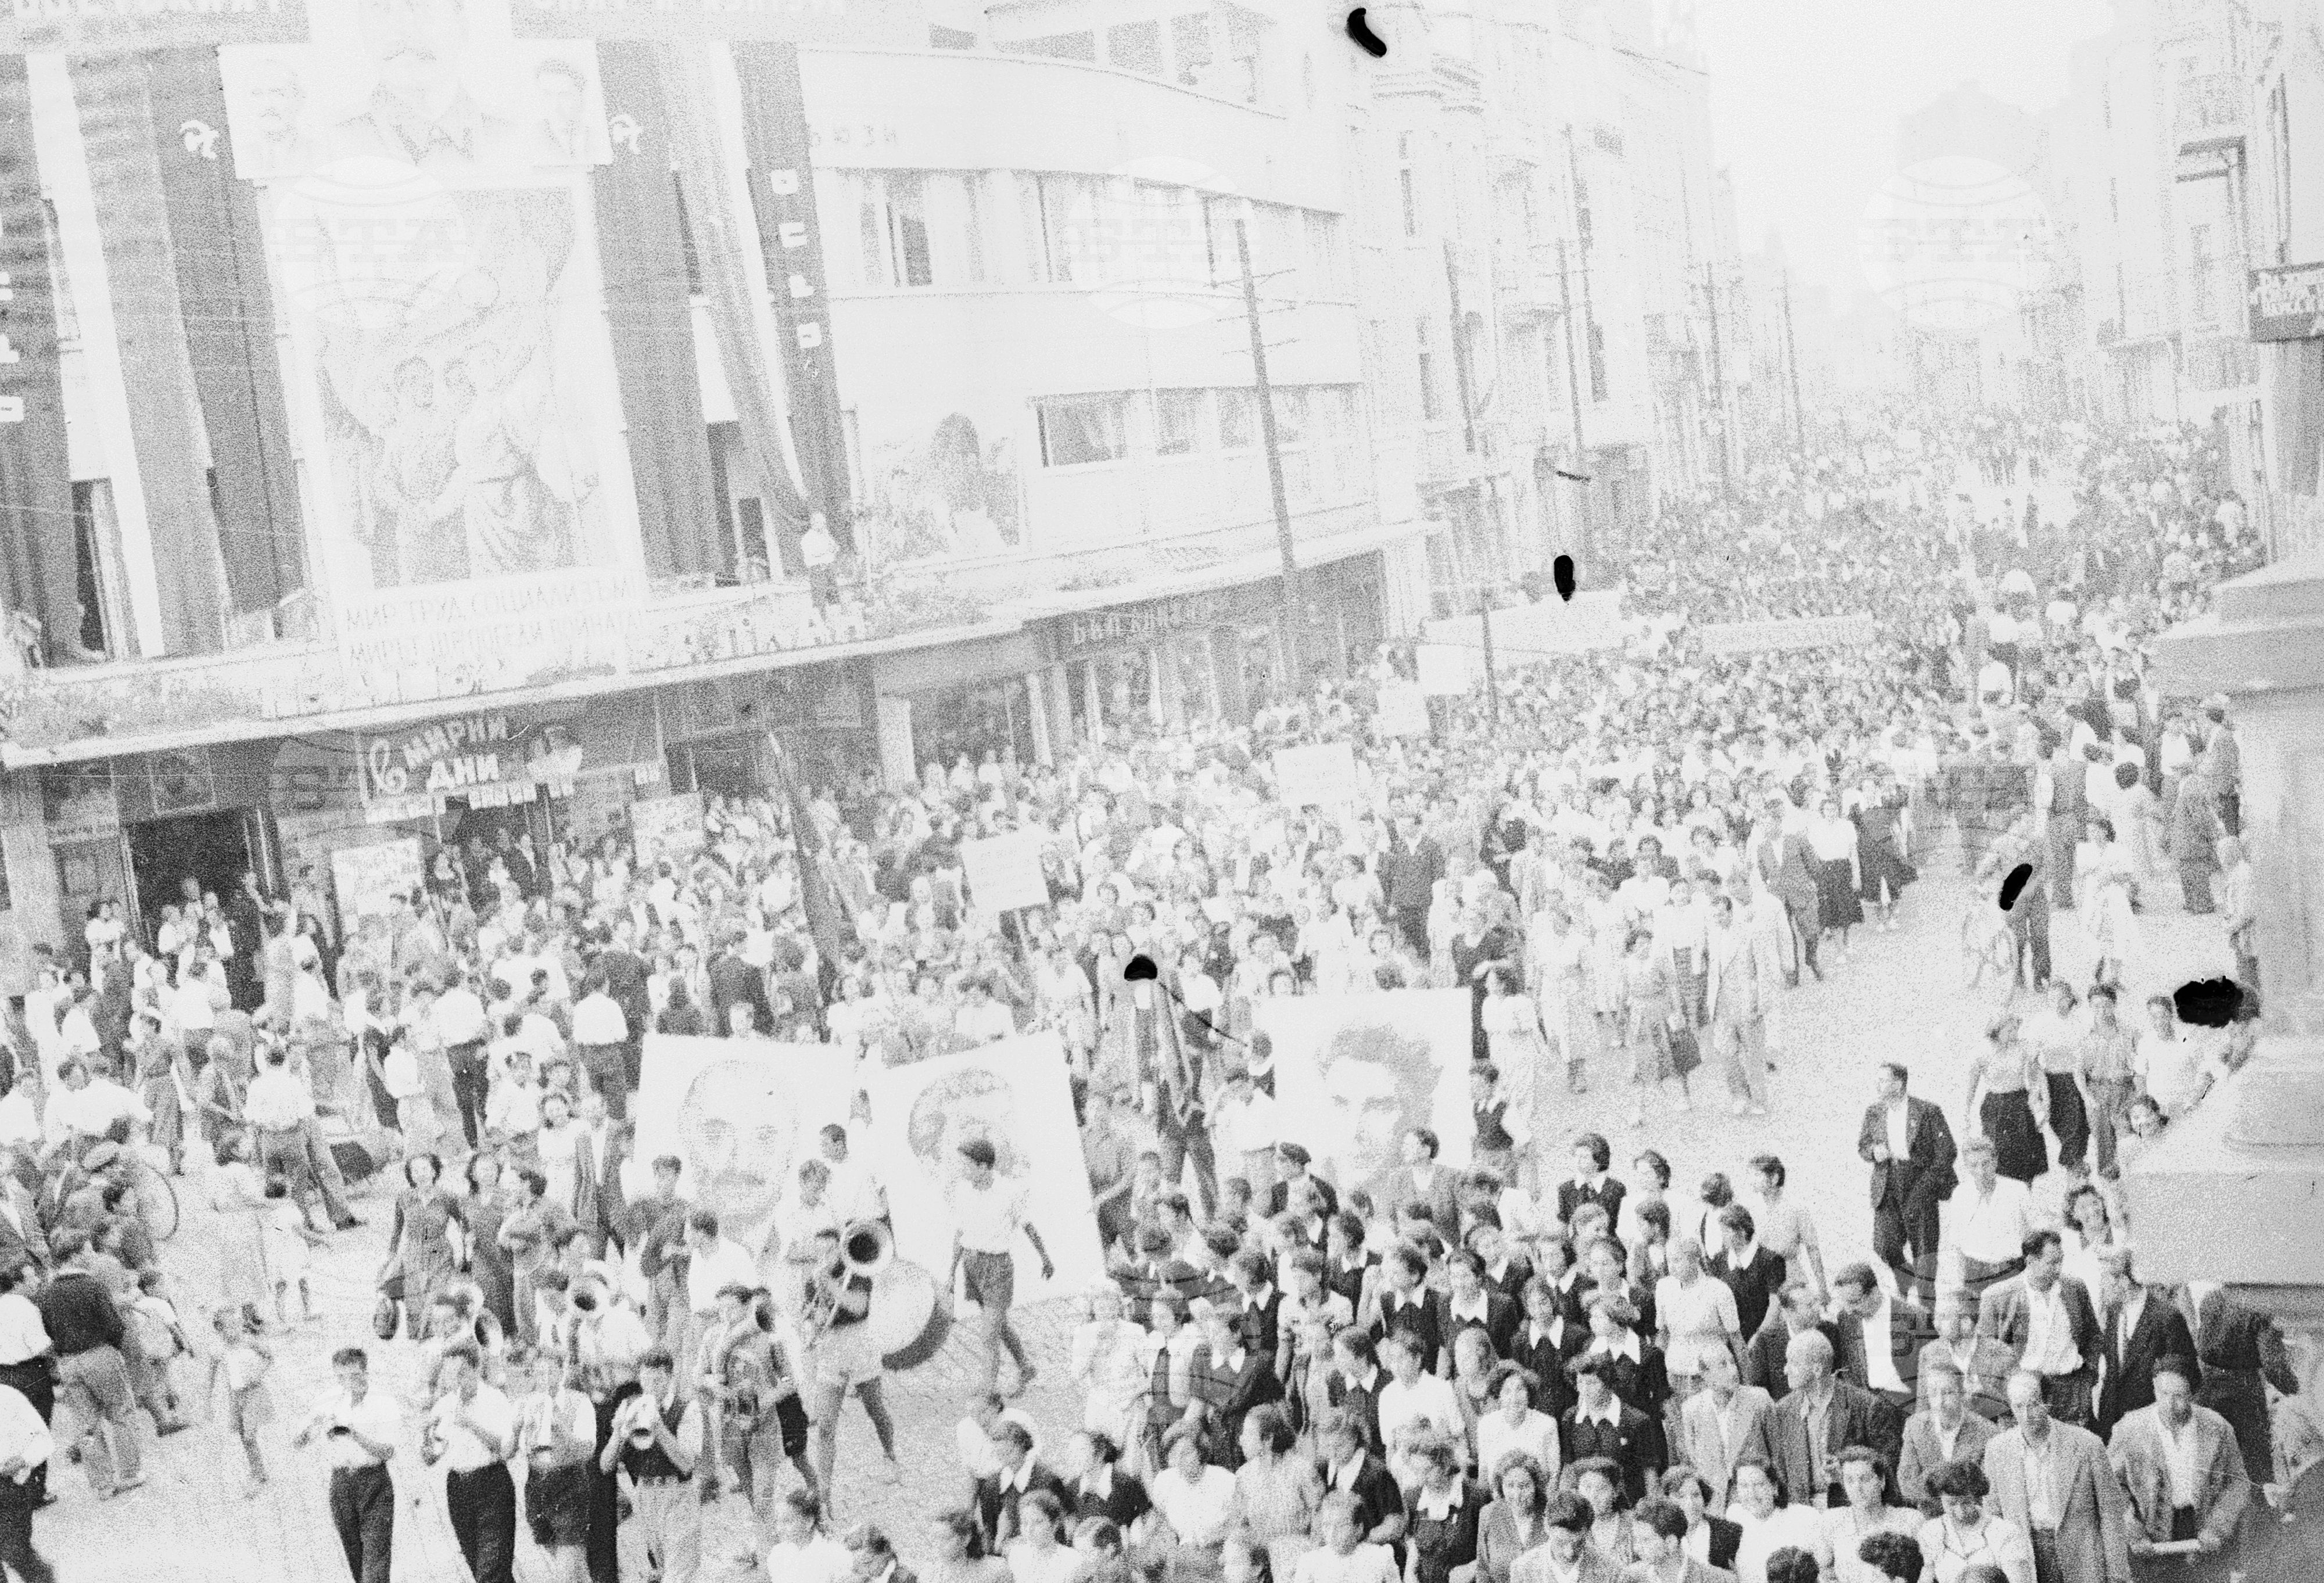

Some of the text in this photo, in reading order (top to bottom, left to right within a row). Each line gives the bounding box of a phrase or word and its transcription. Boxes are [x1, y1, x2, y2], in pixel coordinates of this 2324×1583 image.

[346, 602, 397, 632] МИР
[404, 596, 467, 623] ТРУД
[403, 716, 508, 771] МИРНИ
[425, 753, 500, 794] ДНИ
